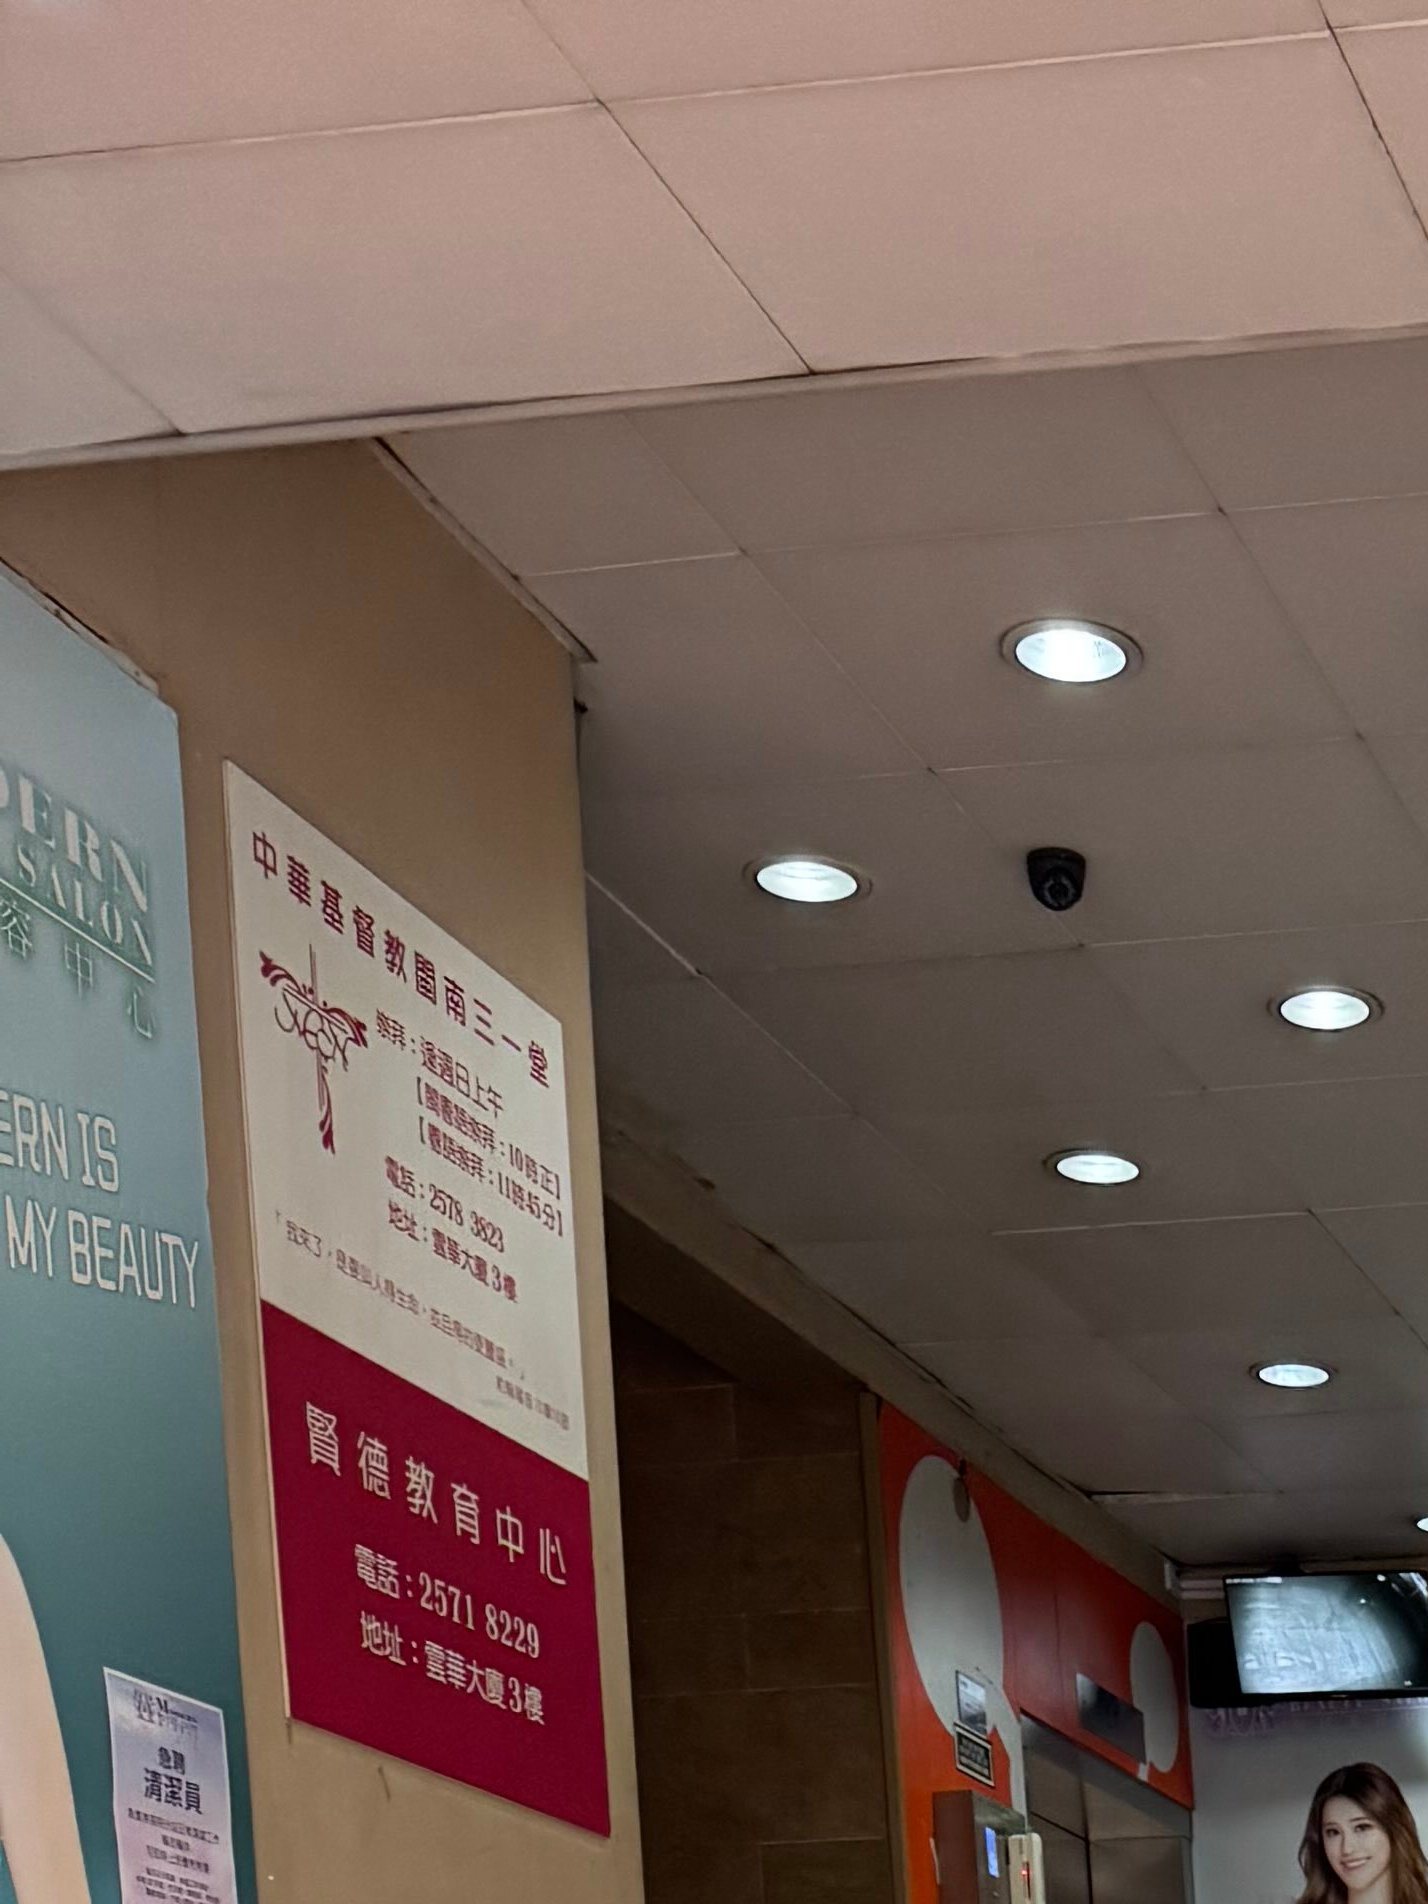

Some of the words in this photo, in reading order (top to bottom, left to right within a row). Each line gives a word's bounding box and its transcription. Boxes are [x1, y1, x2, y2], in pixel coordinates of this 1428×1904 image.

[0, 766, 148, 912] ERN
[252, 831, 549, 1089] 中華基督教閩南三一堂
[76, 1112, 119, 1193] IS
[5, 1194, 57, 1278] MY
[67, 1209, 199, 1309] BEAUTY
[306, 1401, 567, 1586] 賢德教育中心
[486, 1602, 540, 1660] 8229
